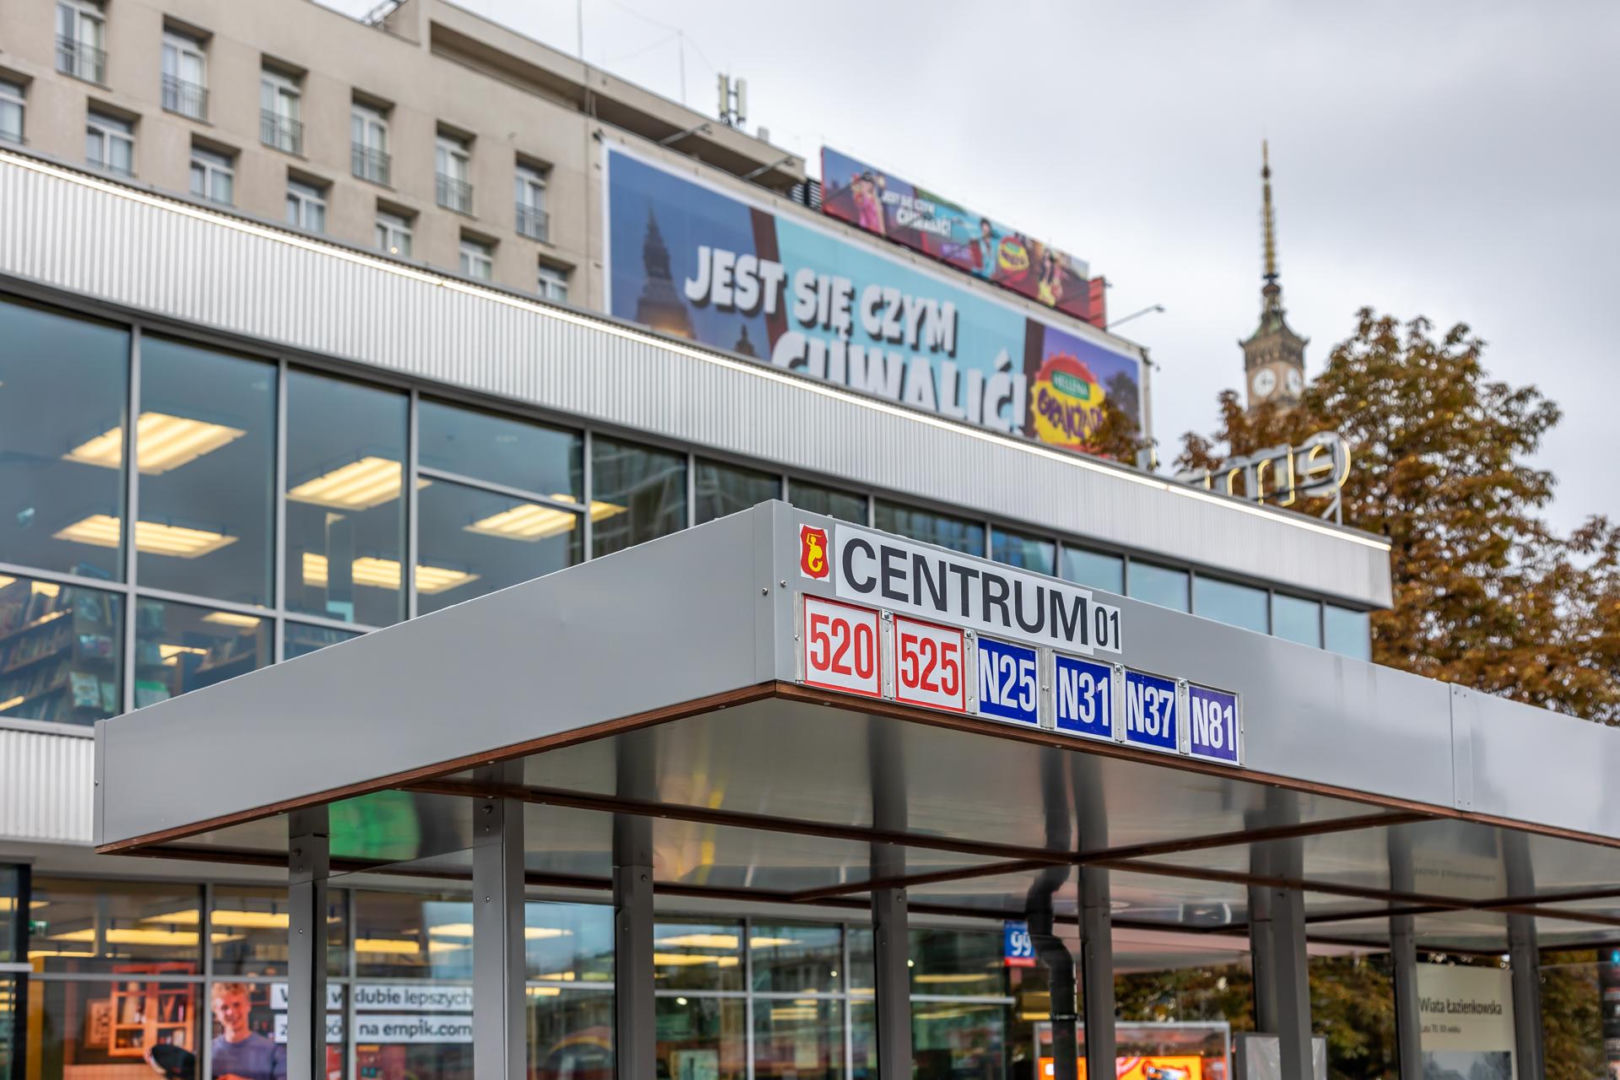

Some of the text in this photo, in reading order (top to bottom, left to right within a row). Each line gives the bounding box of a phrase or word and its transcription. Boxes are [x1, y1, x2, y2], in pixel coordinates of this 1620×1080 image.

[684, 245, 956, 352] JEST SIĘ CZYM
[842, 537, 1119, 650] CENTRUM 01
[810, 612, 1235, 752] 520 525 N25 N31 N37 N81
[1010, 931, 1032, 957] 99
[359, 1024, 379, 1036] na
[383, 1018, 473, 1038] empik.com
[404, 988, 473, 1008] lepszych
